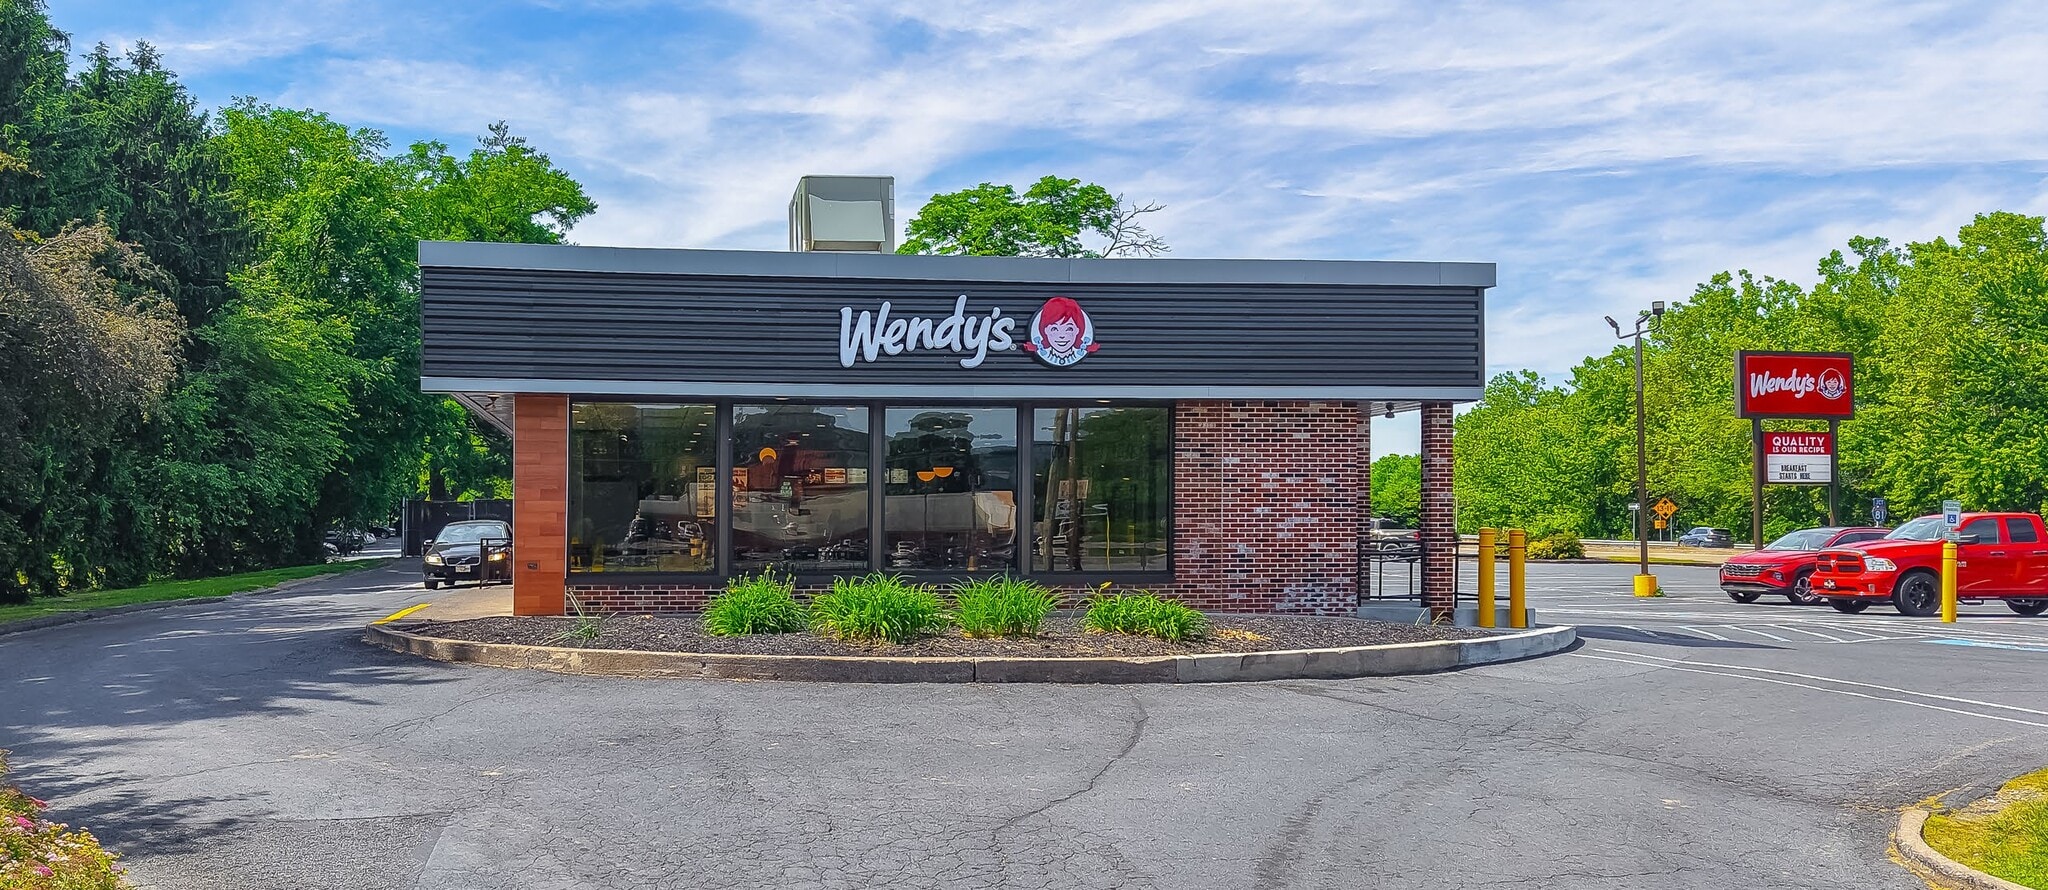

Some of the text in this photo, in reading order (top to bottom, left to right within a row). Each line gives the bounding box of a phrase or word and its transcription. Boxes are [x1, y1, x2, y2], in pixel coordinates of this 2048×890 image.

[840, 294, 1016, 369] Wendy's
[1750, 368, 1815, 399] Wendy's
[1772, 436, 1825, 446] QUALITY
[1780, 464, 1808, 472] BREAKFAST
[1778, 472, 1811, 480] STARTS HERE
[1875, 510, 1884, 520] 81
